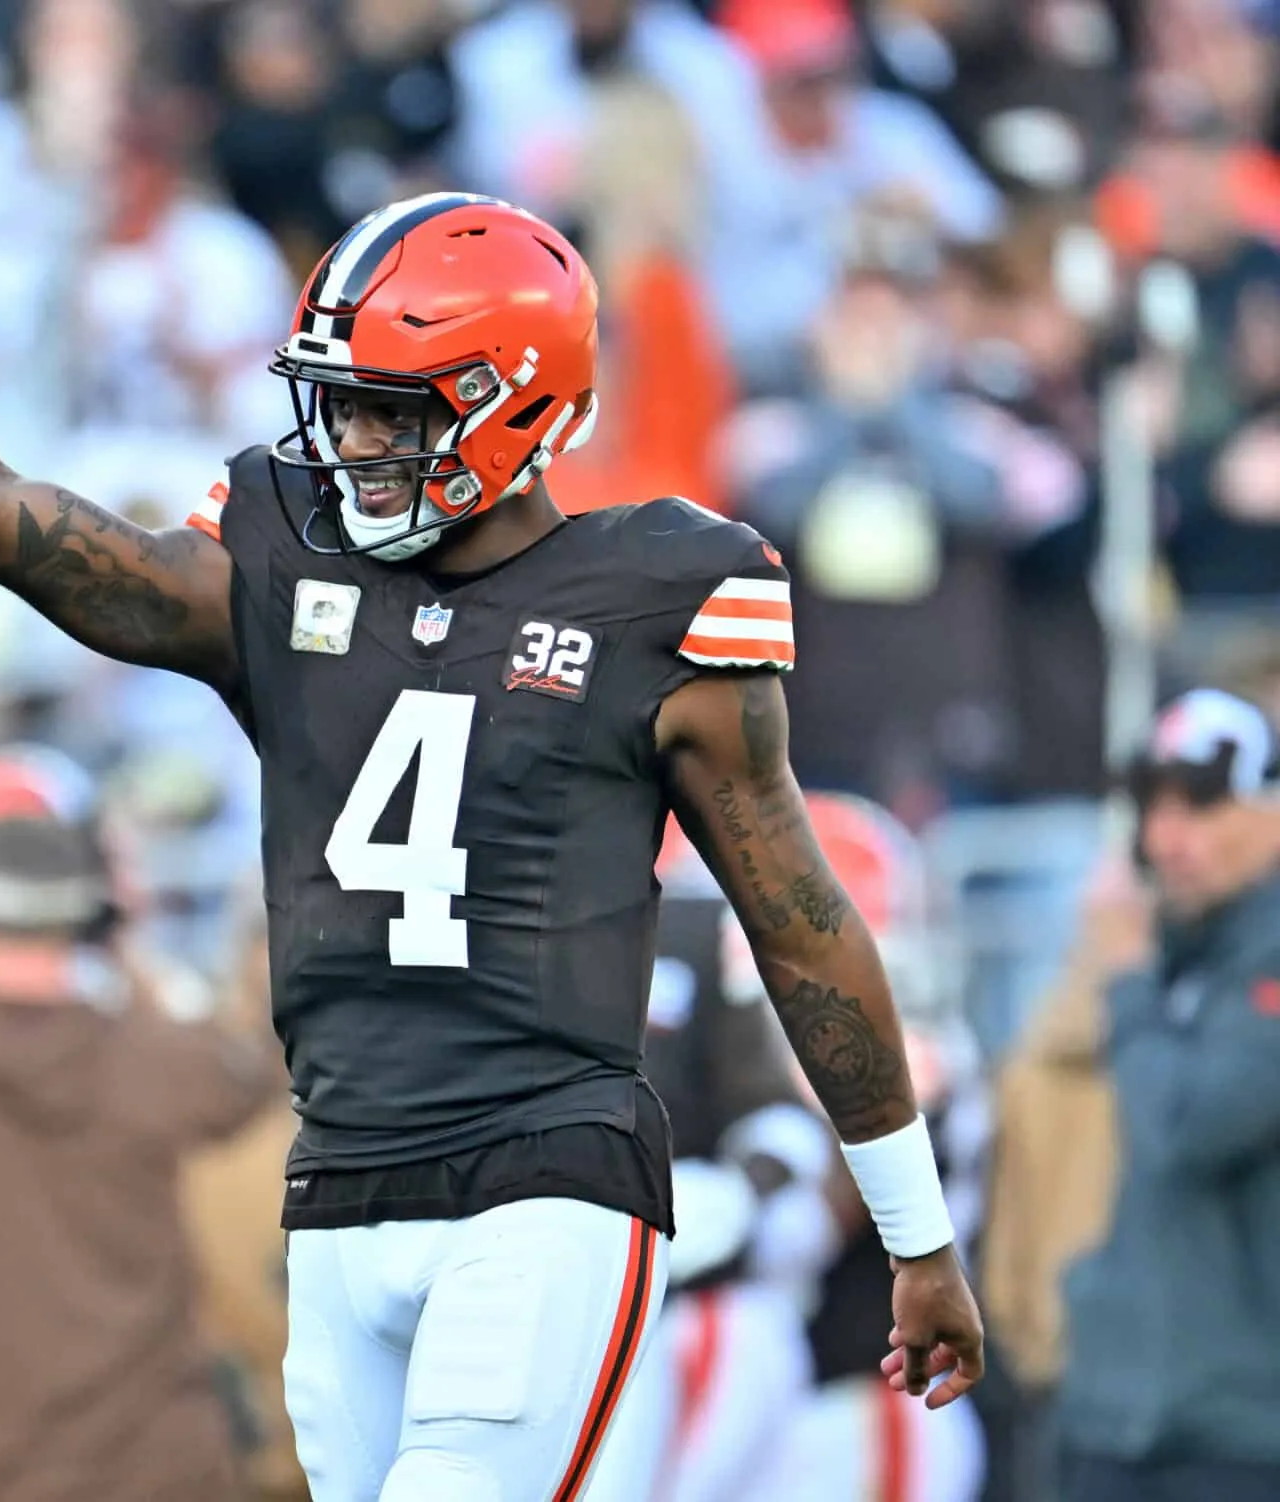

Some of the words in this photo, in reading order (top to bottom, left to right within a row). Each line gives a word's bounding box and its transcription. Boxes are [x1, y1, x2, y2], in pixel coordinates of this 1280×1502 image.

[418, 621, 446, 637] NFL
[512, 621, 593, 686] 32
[324, 688, 476, 968] 4
